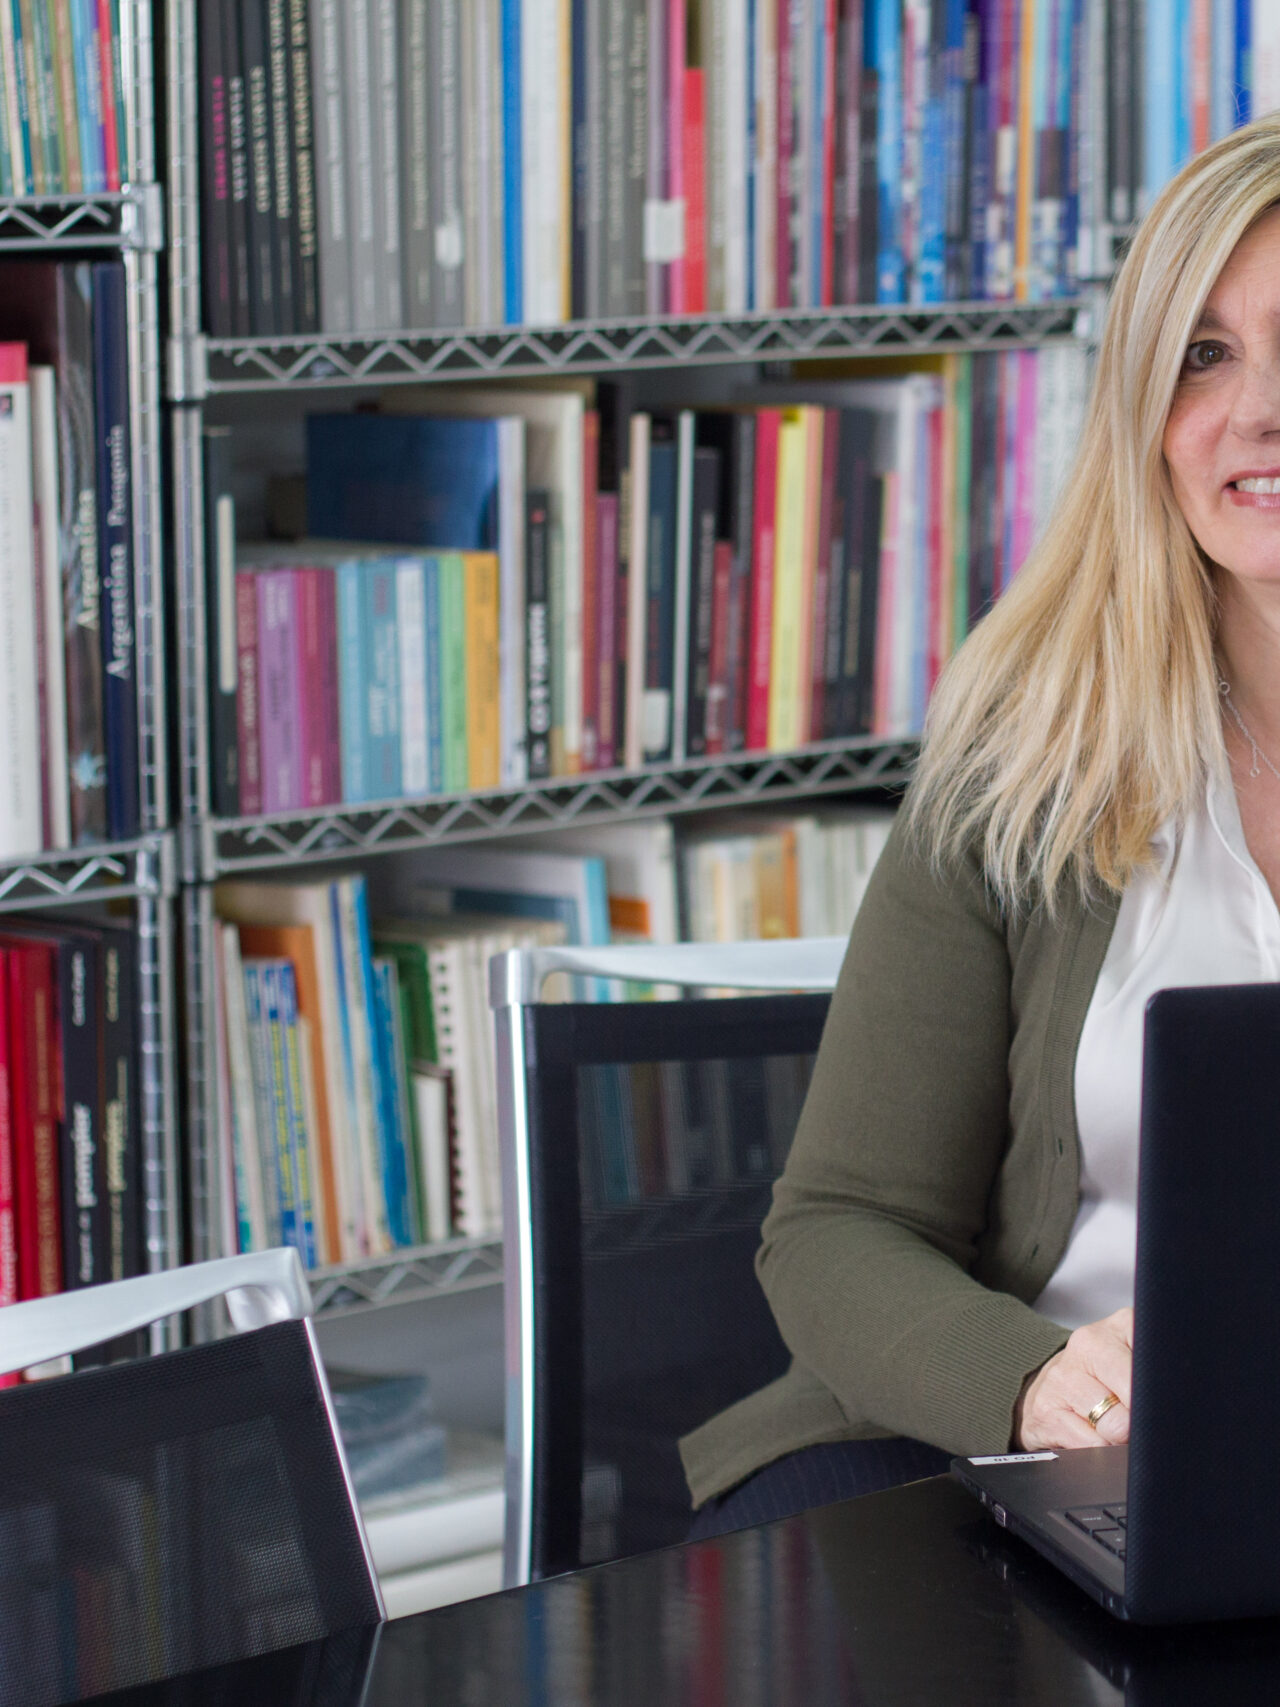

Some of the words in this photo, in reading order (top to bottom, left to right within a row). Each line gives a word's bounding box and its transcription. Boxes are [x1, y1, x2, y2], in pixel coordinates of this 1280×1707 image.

[105, 424, 128, 527] Patagonia
[73, 489, 101, 631] Argentina
[103, 544, 134, 681] Argentina
